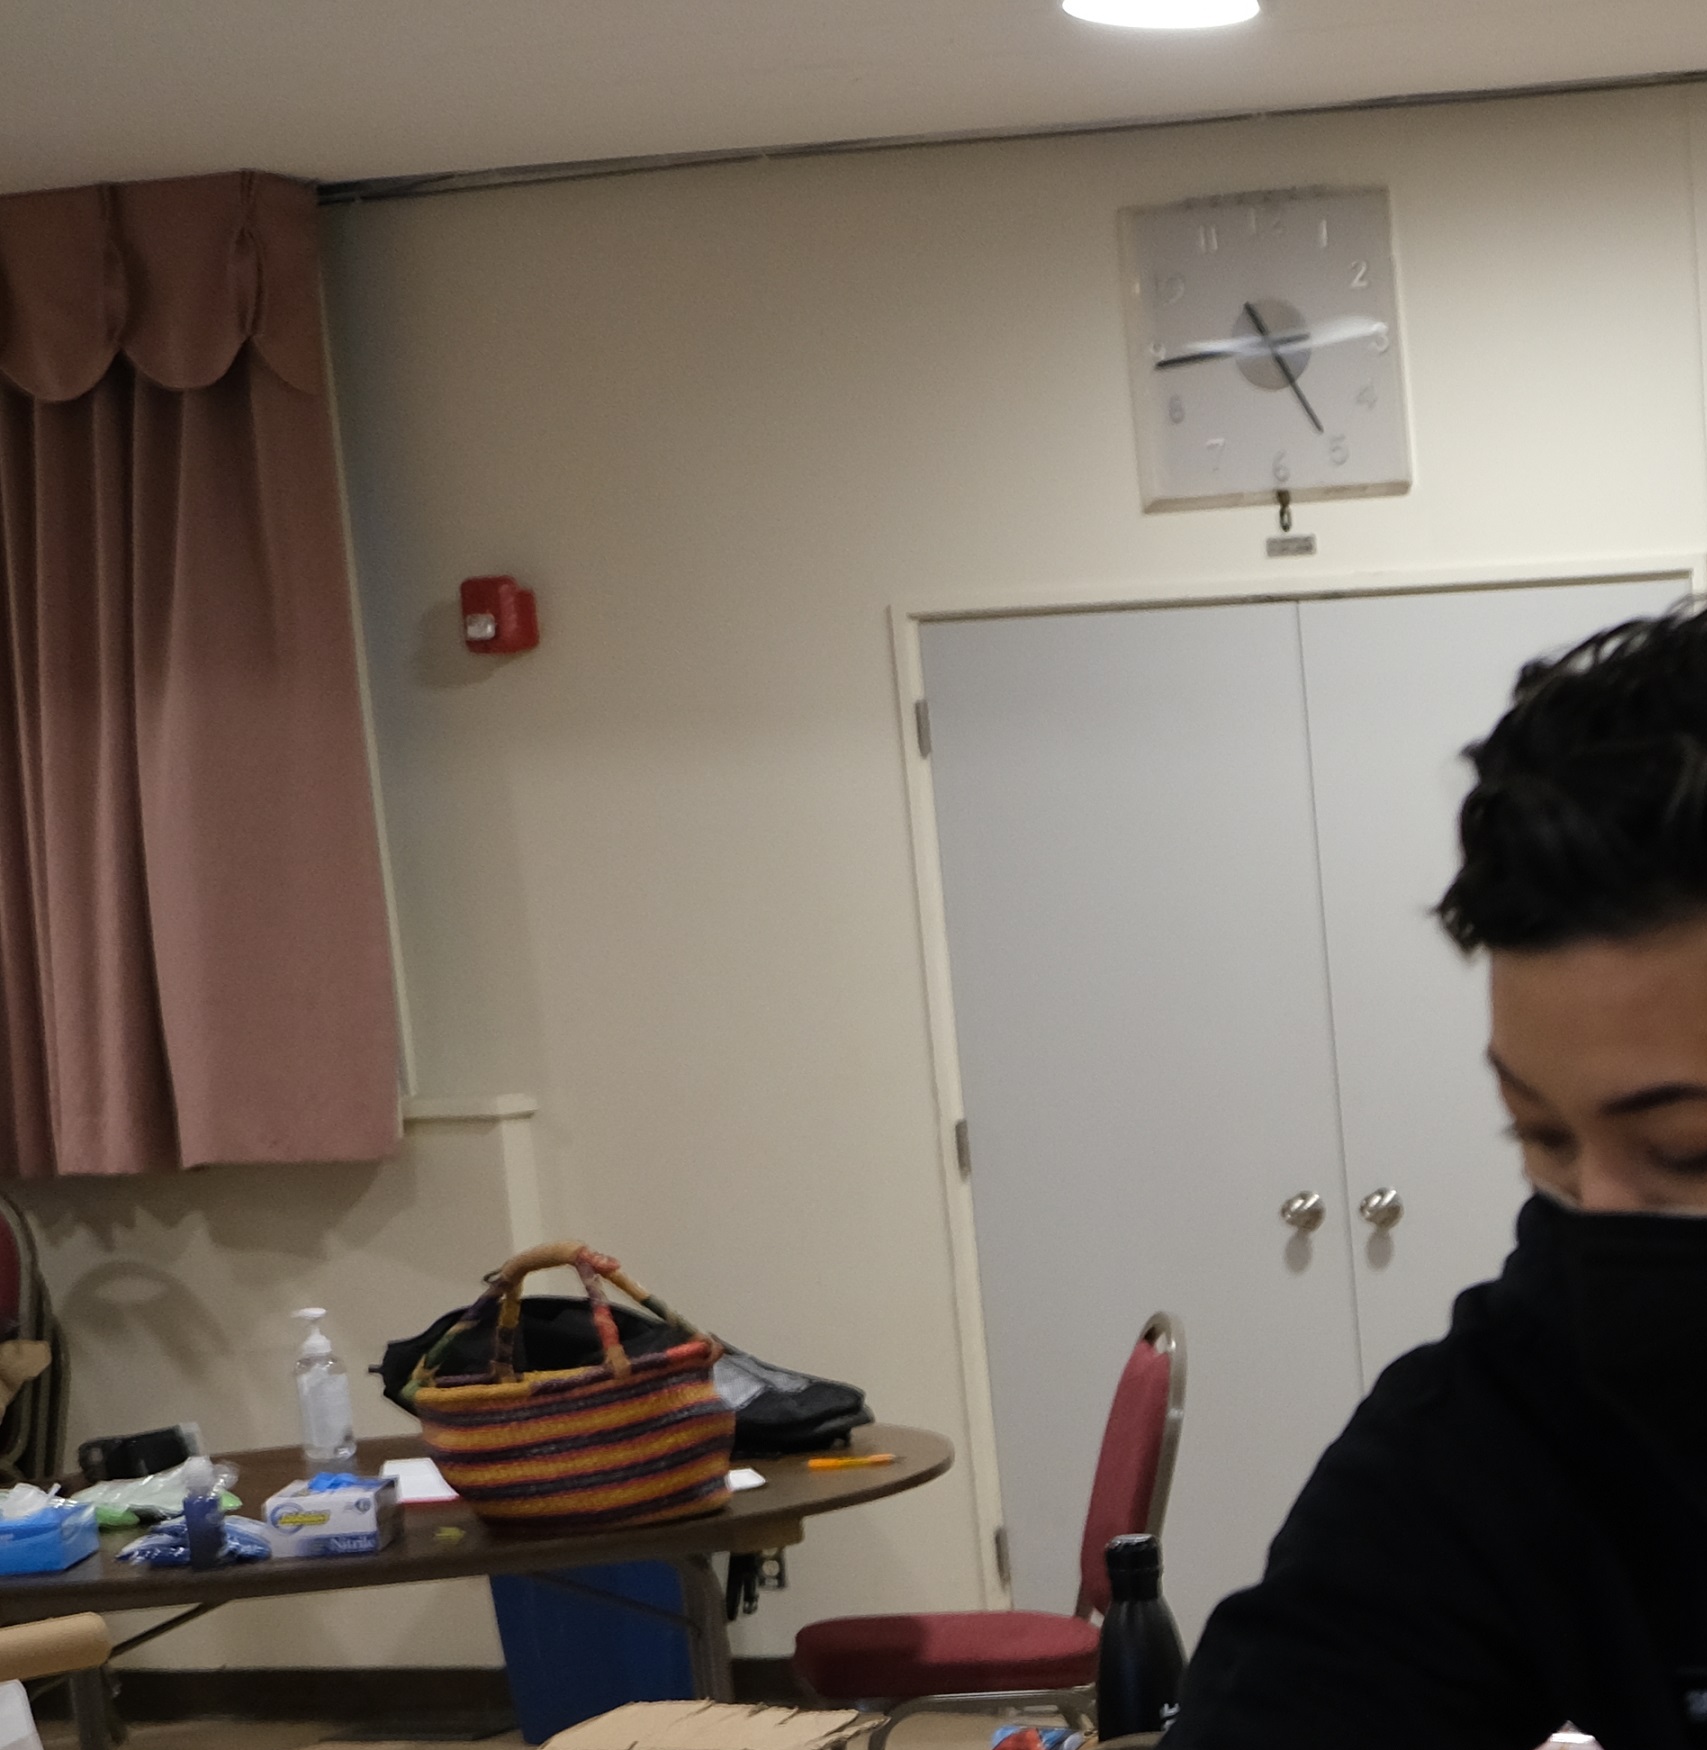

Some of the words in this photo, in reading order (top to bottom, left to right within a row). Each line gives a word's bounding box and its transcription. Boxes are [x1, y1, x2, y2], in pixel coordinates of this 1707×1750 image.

[1348, 259, 1370, 289] 2
[1272, 450, 1291, 483] 6
[331, 1536, 376, 1553] Nitrile
